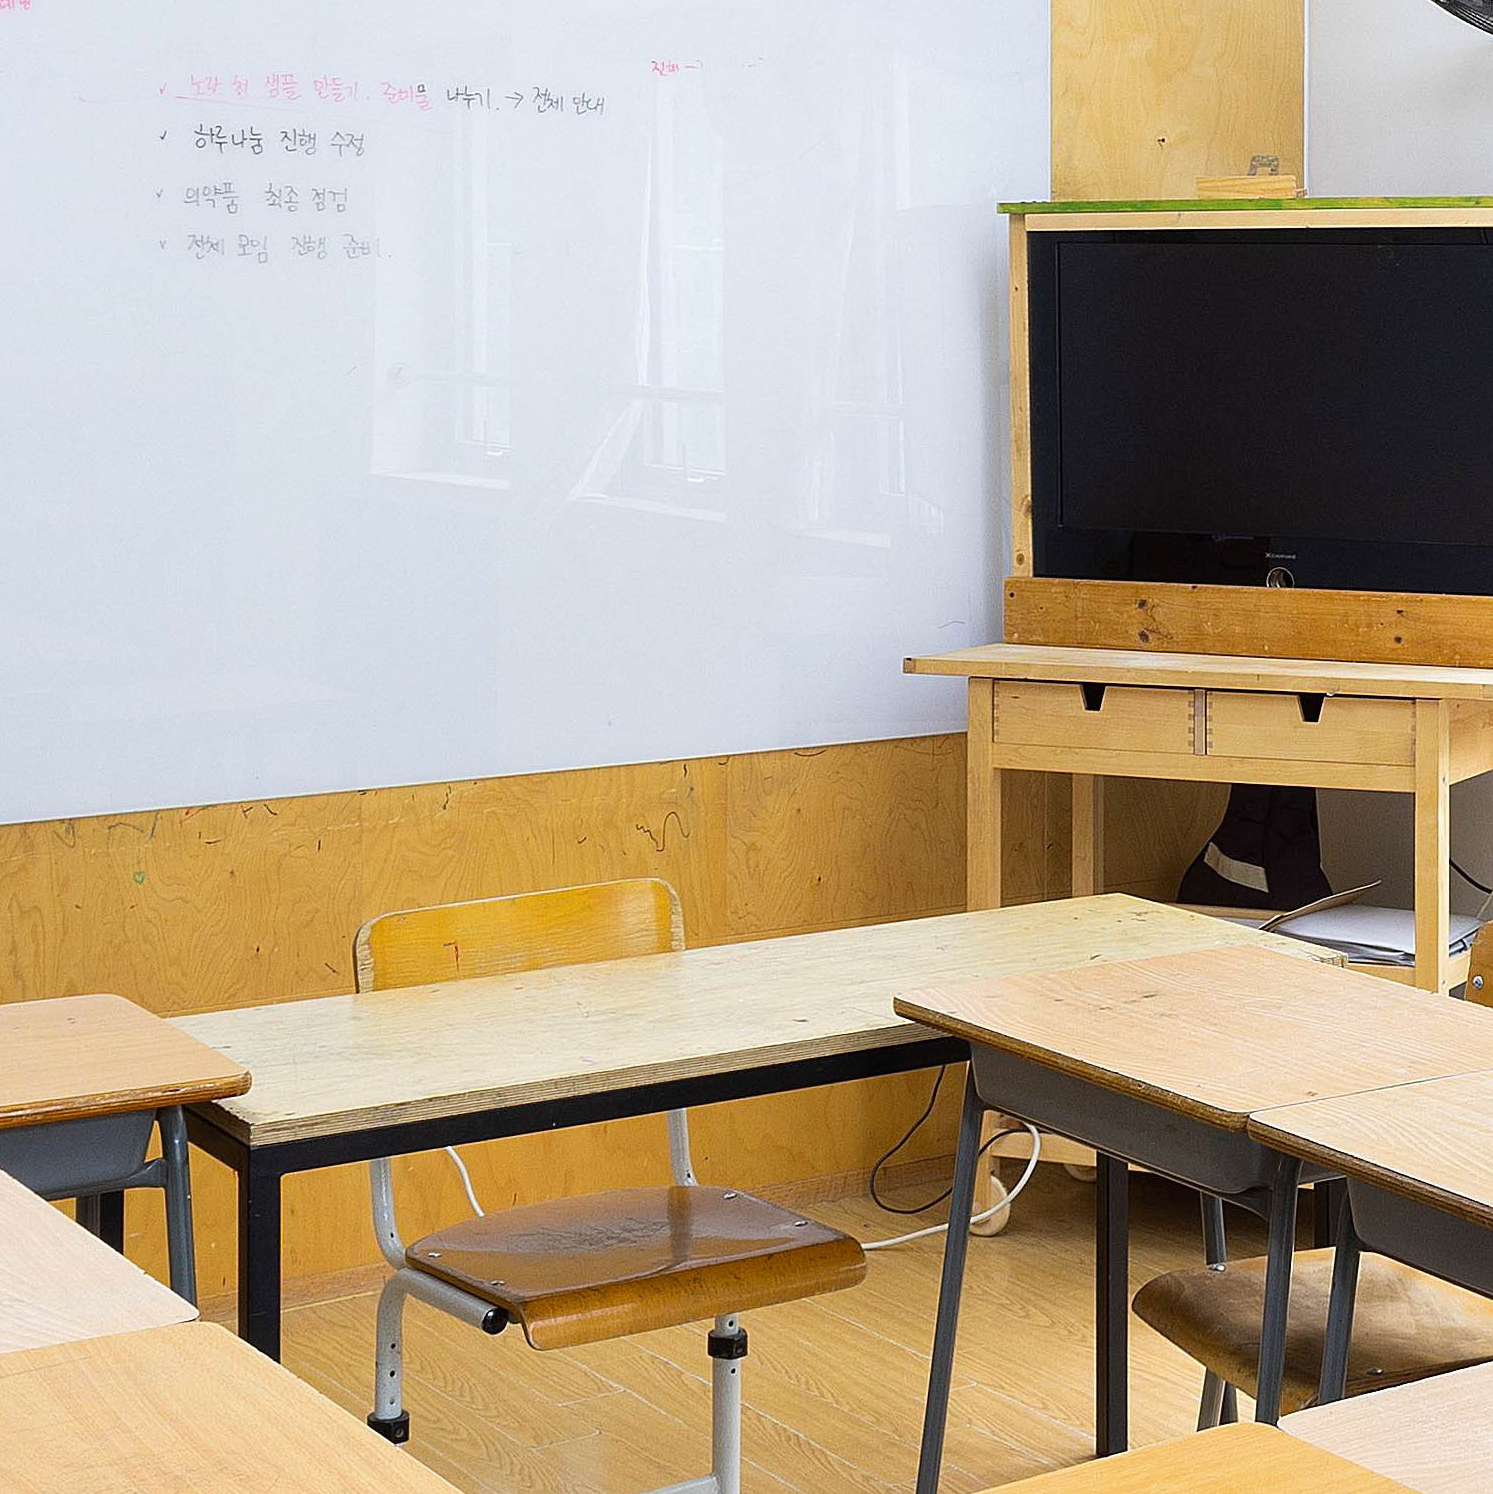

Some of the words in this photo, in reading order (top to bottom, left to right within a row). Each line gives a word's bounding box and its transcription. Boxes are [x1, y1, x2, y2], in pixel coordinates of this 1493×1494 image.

[193, 123, 264, 156] 하루나눔
[279, 127, 317, 156] 진행
[330, 130, 365, 157] 수정
